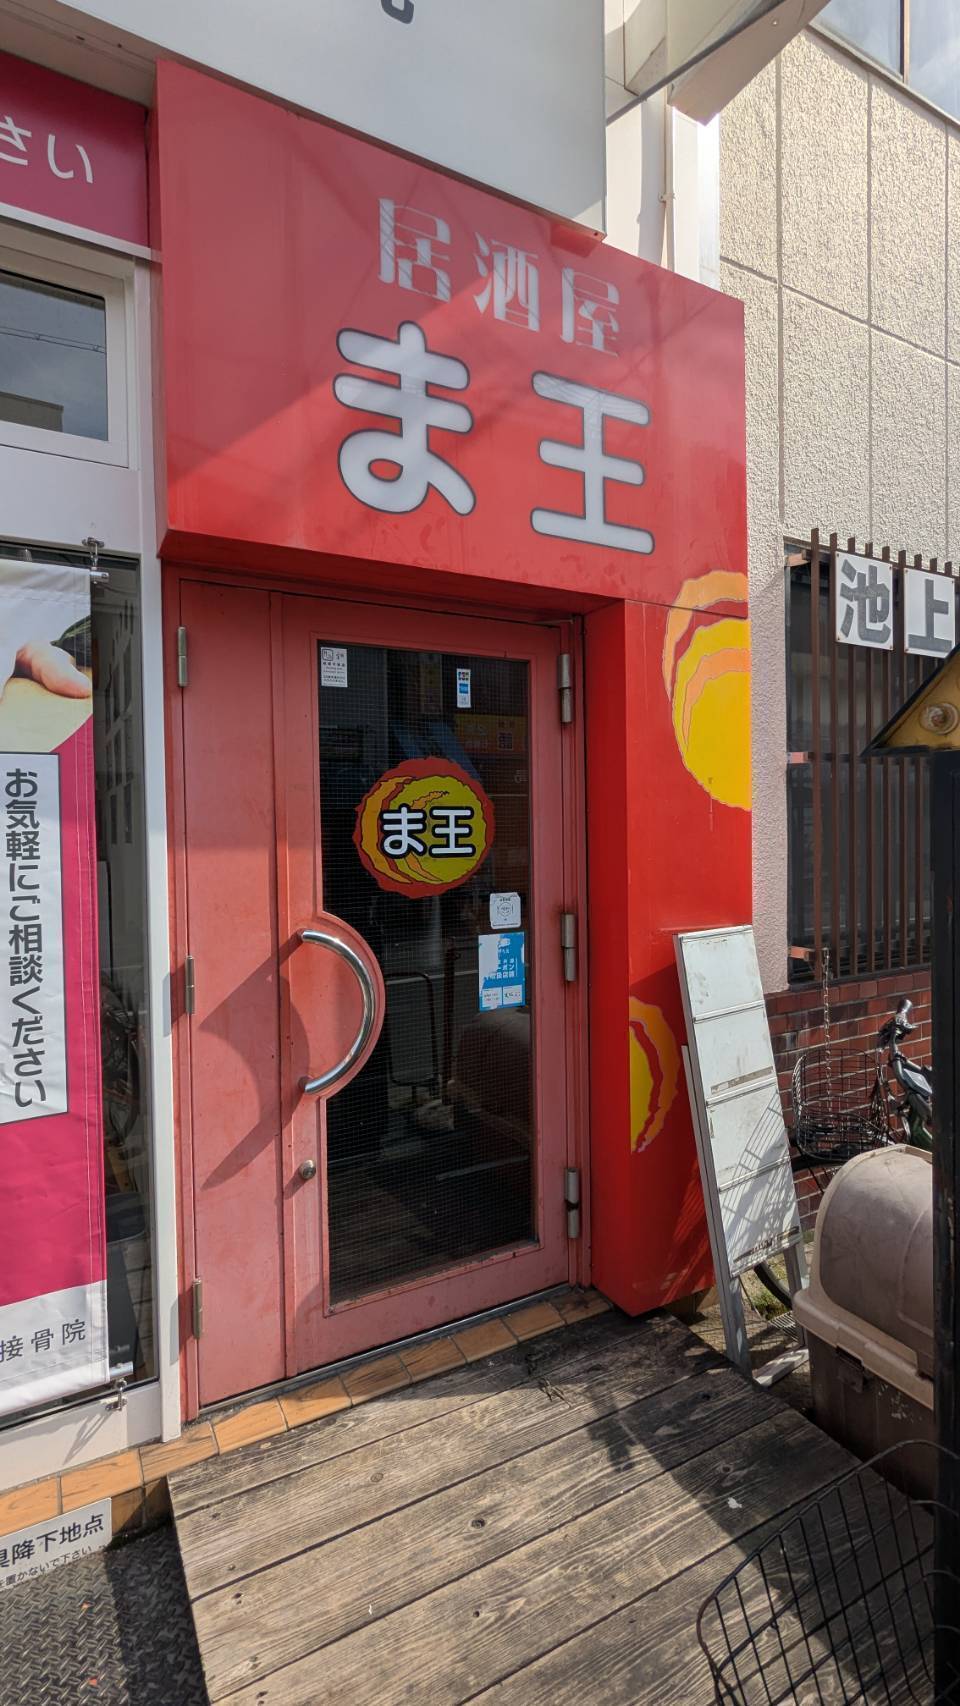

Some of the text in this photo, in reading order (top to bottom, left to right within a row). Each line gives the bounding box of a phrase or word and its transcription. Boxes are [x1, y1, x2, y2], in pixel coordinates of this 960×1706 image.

[0, 115, 93, 184] さい
[377, 198, 620, 358] 居酒屋
[333, 320, 656, 555] ま王
[839, 558, 952, 649] 池上
[381, 804, 476, 857] ま王
[4, 767, 46, 1109] お気軽にご相談ください
[0, 1318, 86, 1363] 接骨院
